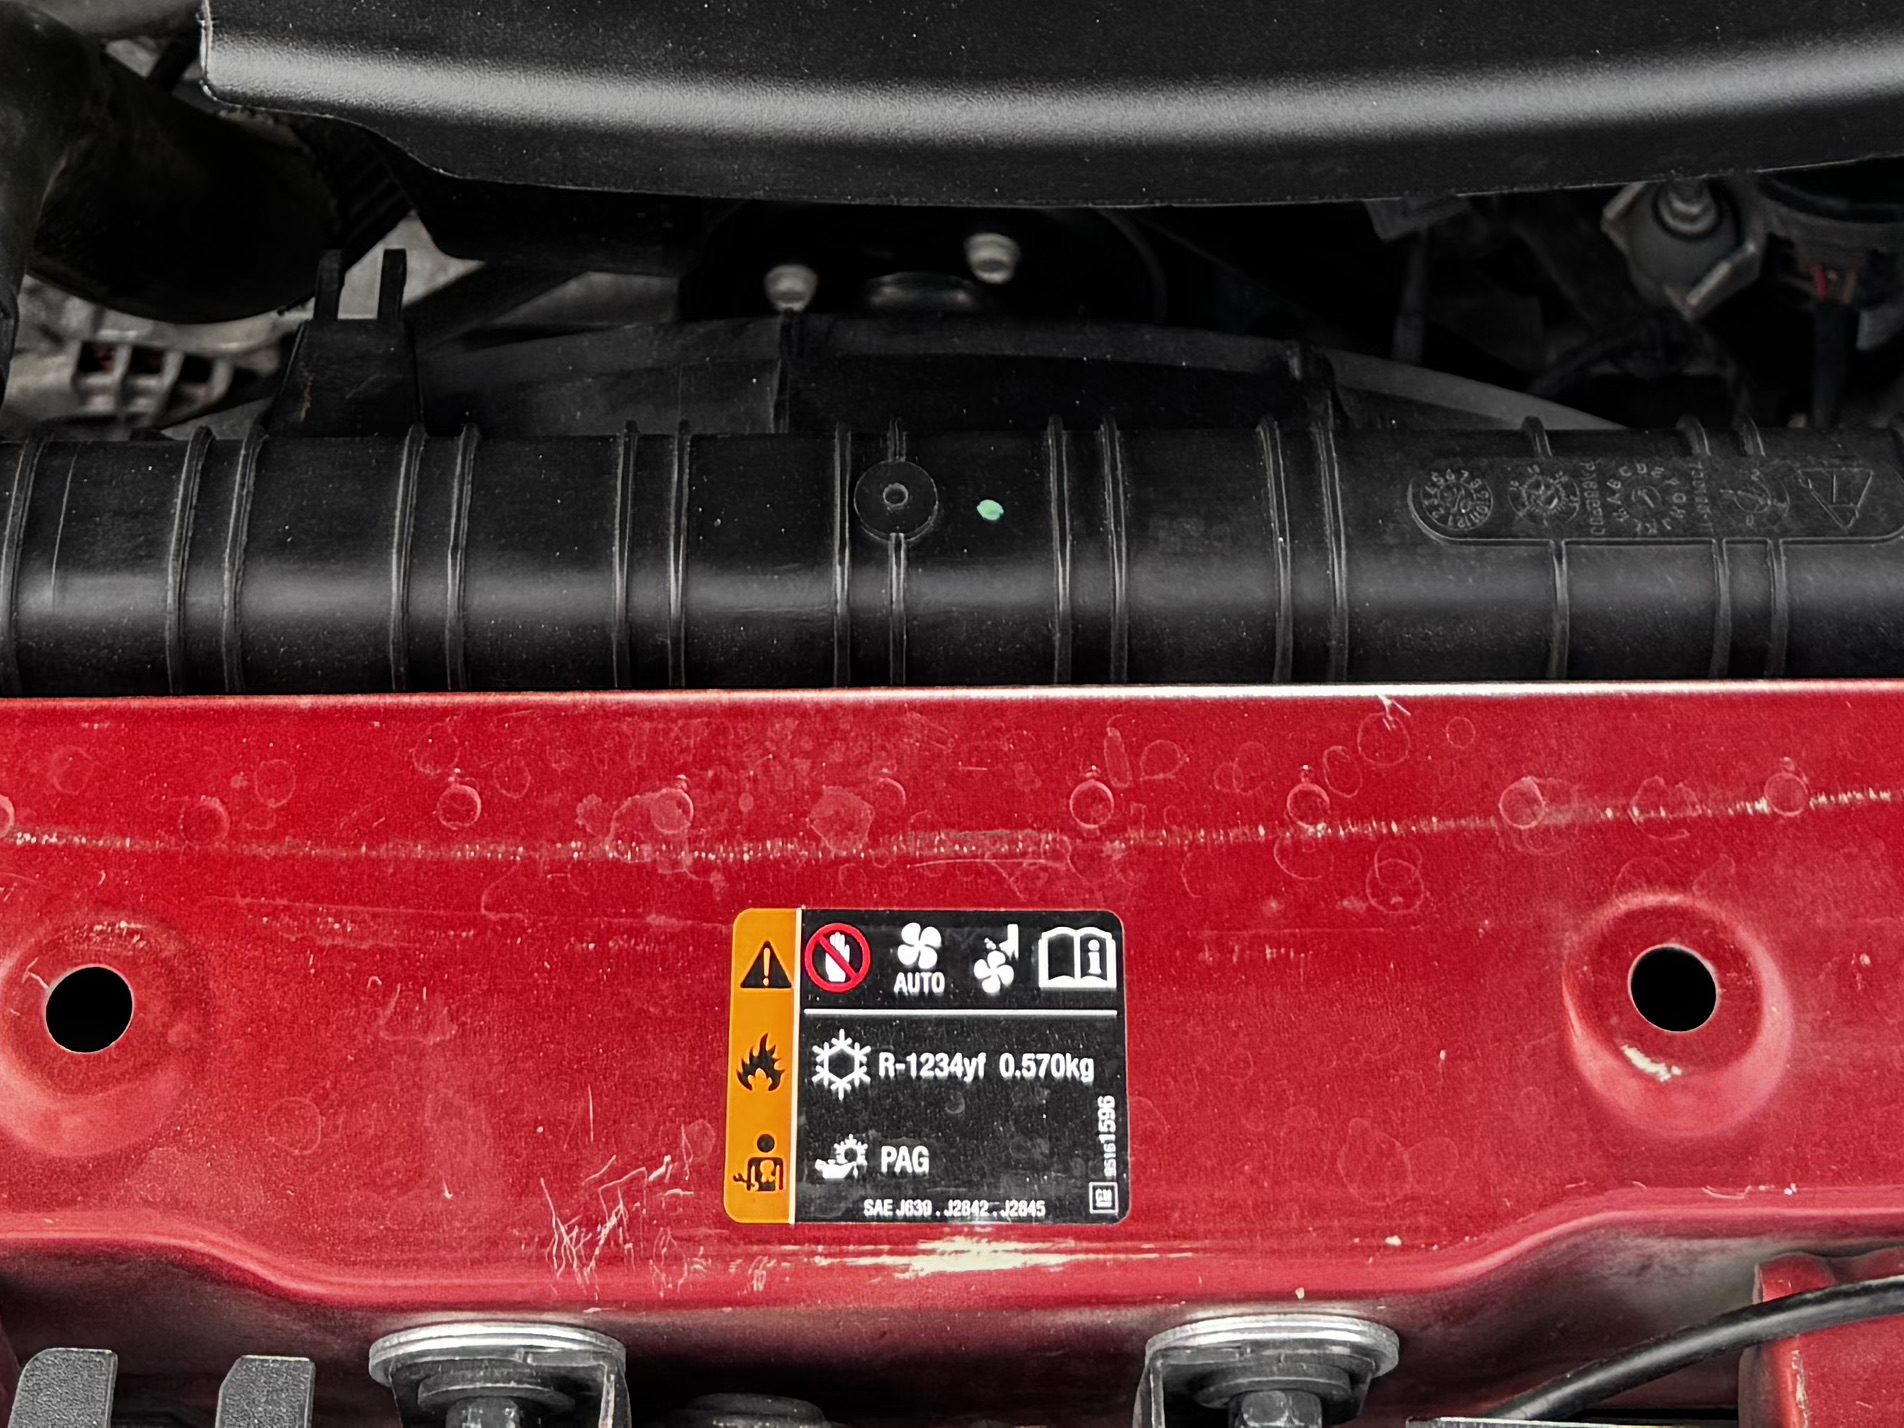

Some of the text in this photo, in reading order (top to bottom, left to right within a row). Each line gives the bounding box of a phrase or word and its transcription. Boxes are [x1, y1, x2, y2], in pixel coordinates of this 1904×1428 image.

[893, 971, 946, 995] AUTO
[878, 1051, 1095, 1085] R-1234yf 0.570kg
[880, 1144, 930, 1174] PAG
[863, 1198, 894, 1217] SAE
[944, 1199, 988, 1218] J2842
[1000, 1199, 1046, 1218] J2845
